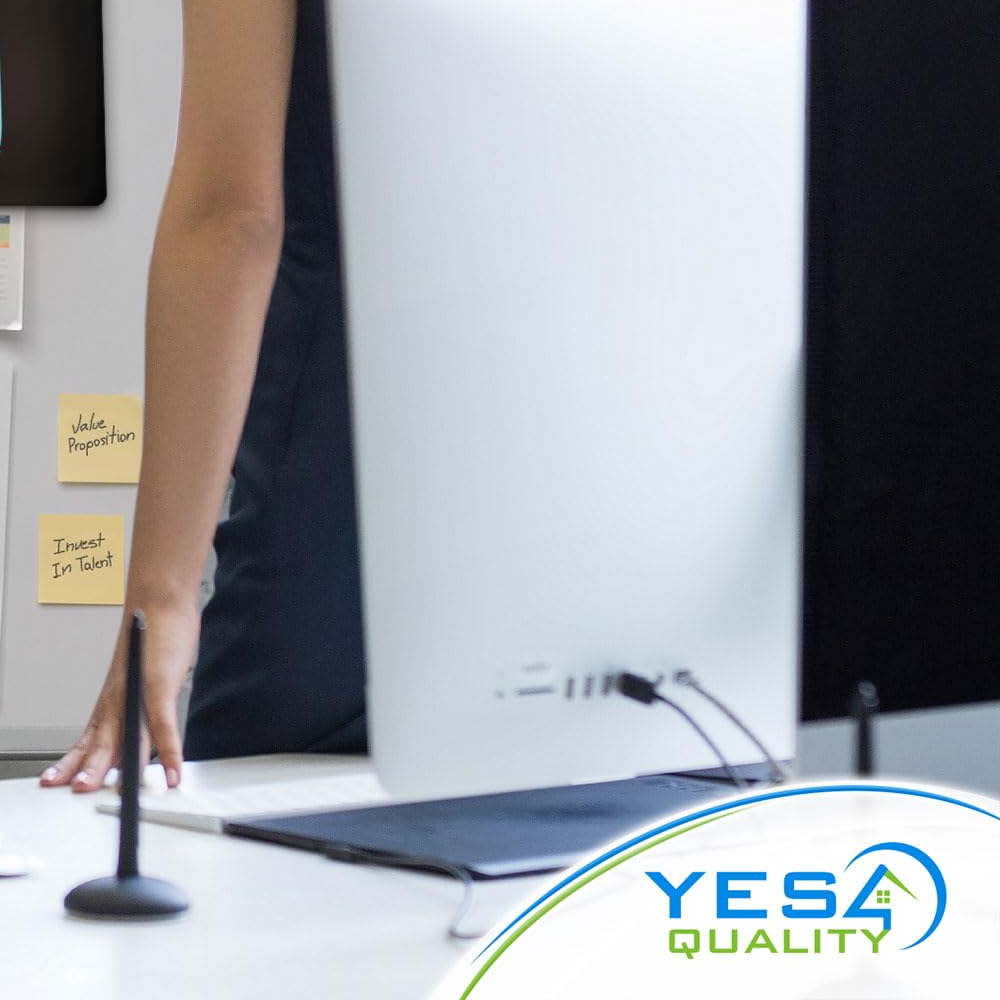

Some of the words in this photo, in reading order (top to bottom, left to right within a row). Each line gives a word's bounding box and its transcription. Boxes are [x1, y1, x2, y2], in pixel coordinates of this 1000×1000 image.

[71, 412, 108, 434] Value
[67, 425, 136, 456] Proposition
[53, 532, 106, 556] Invest
[52, 562, 72, 579] In
[75, 550, 114, 572] Talent
